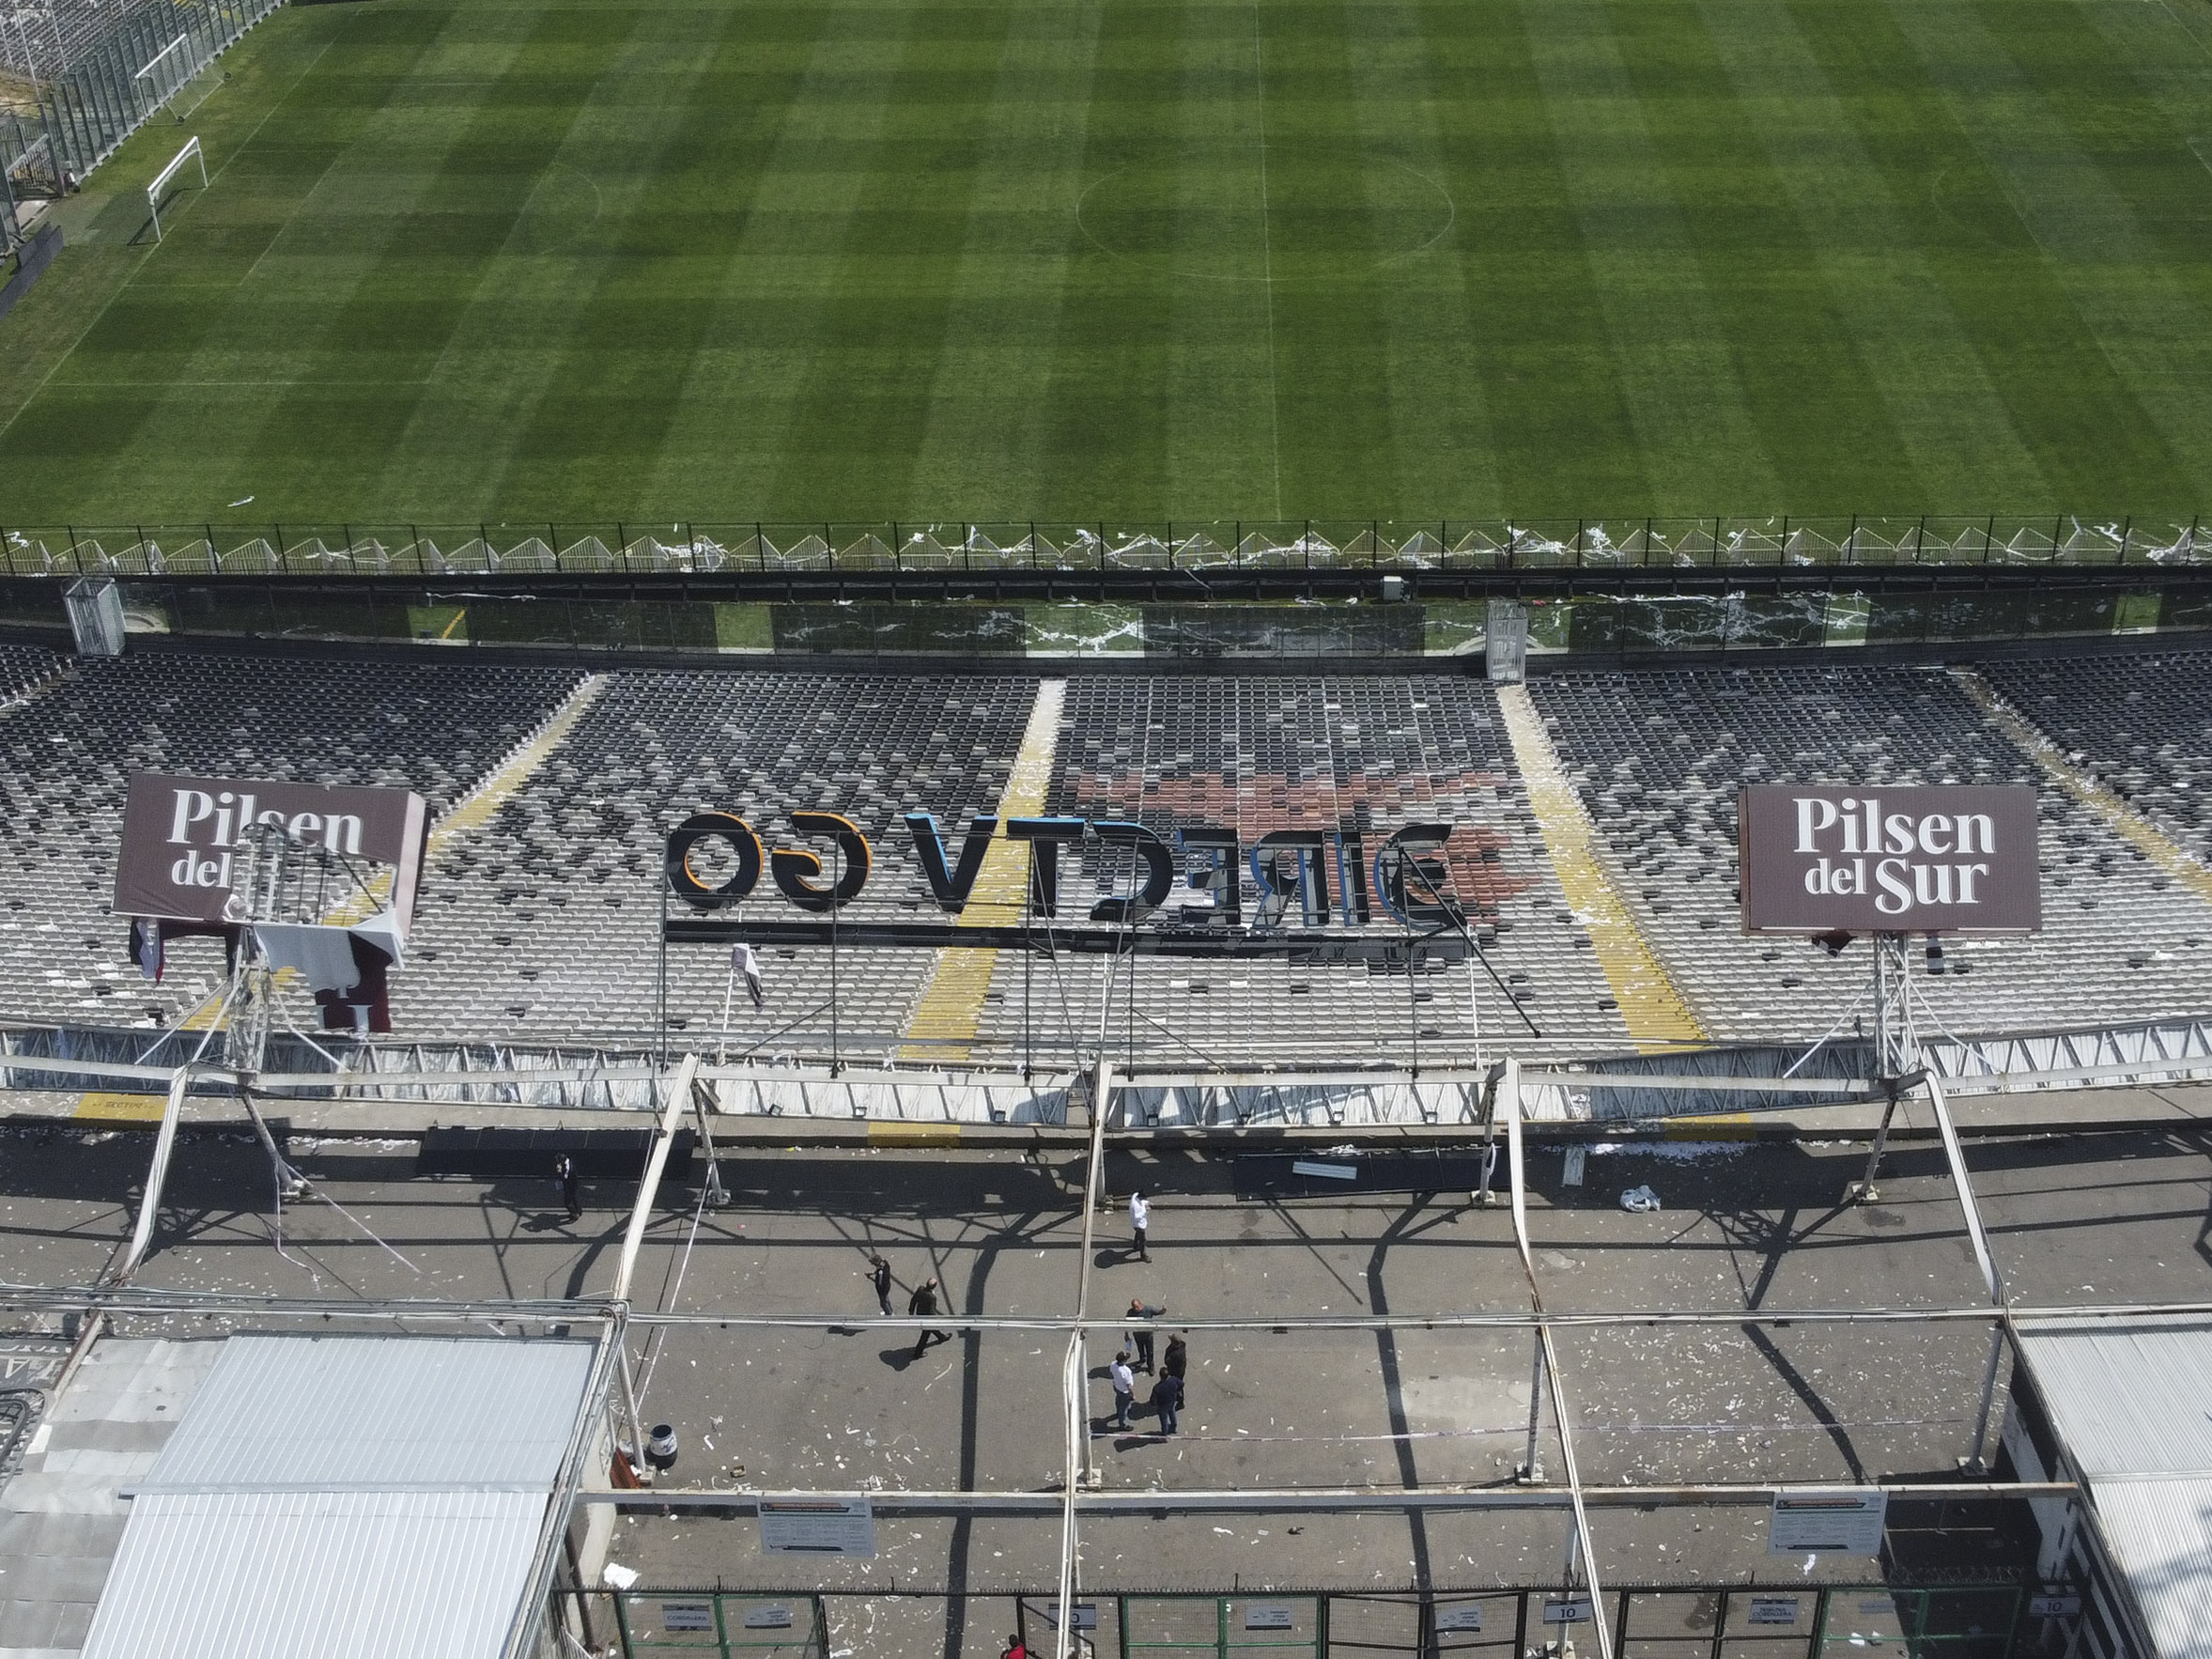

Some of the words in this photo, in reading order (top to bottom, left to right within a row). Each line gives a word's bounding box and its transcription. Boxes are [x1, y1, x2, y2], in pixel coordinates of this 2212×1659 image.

[1792, 797, 1997, 855] Pilsen
[171, 849, 234, 889] del
[1804, 857, 1868, 895] del
[1874, 858, 1989, 915] Sur
[1560, 1607, 1576, 1619] 10
[2046, 1601, 2064, 1613] 10
